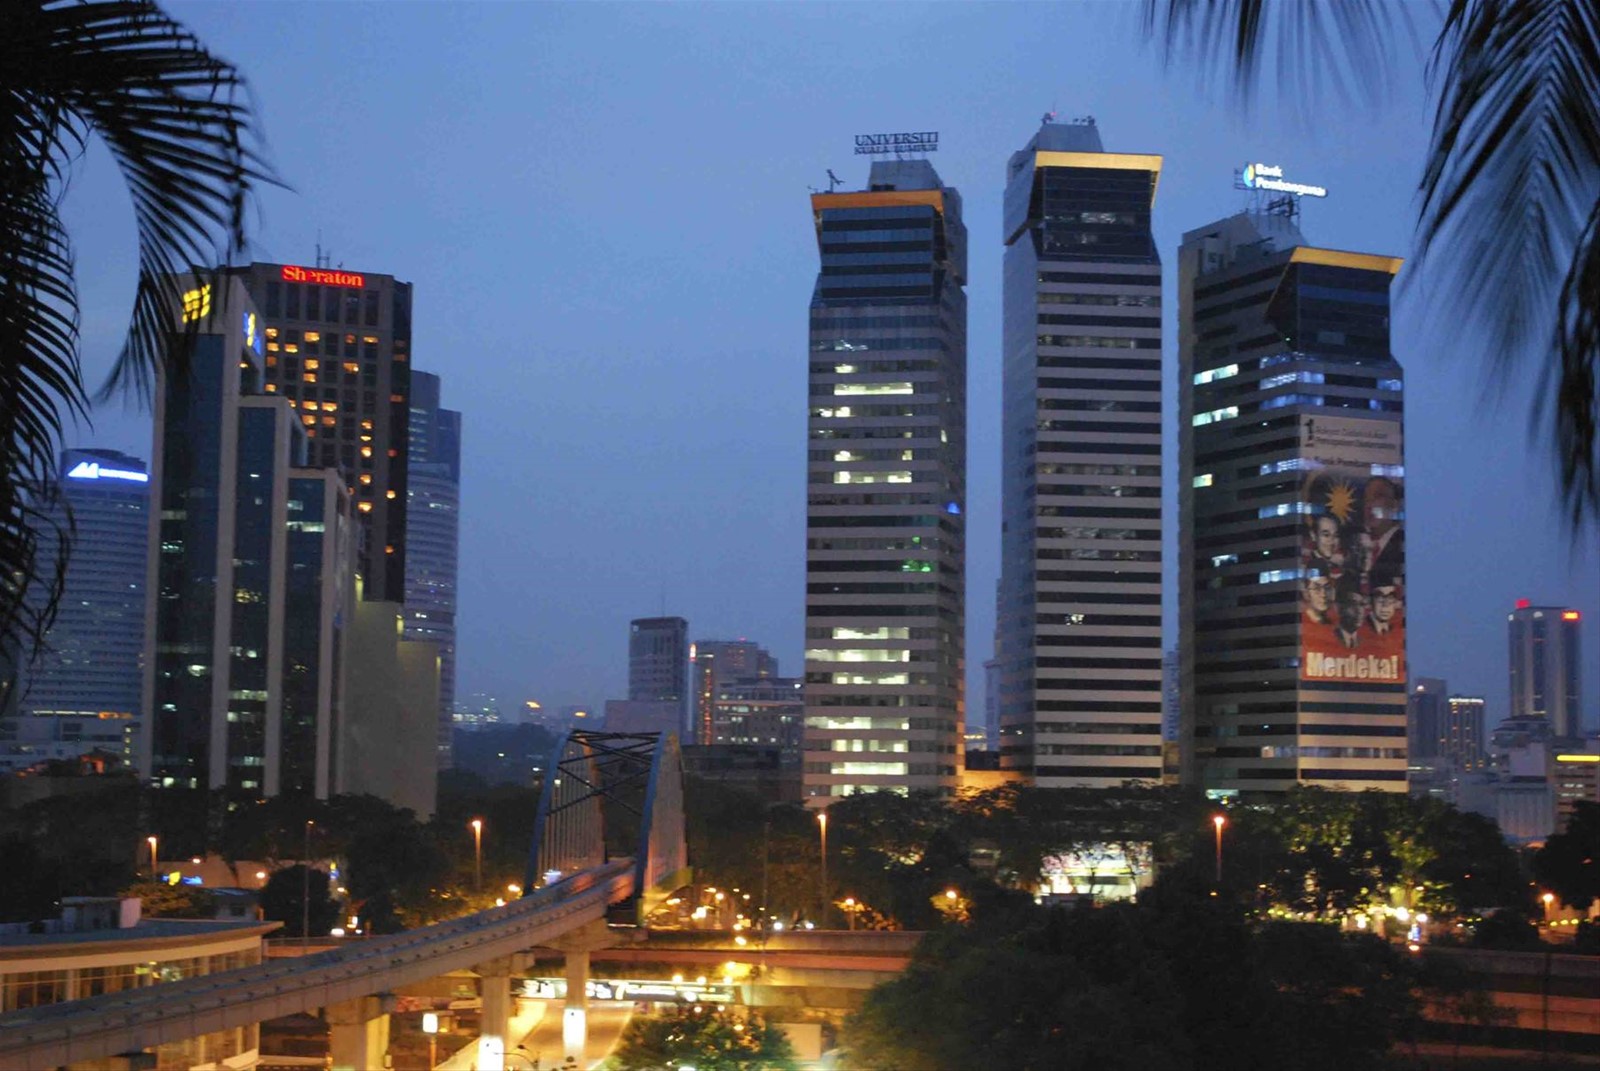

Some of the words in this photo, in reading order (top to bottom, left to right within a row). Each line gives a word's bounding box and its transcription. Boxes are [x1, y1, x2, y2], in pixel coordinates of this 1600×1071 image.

[854, 132, 938, 146] UNIVERSITI
[854, 146, 889, 155] KUALA
[894, 144, 938, 153] LUMPUR
[1255, 163, 1282, 177] Bank
[1306, 652, 1399, 679] Merdeka!
